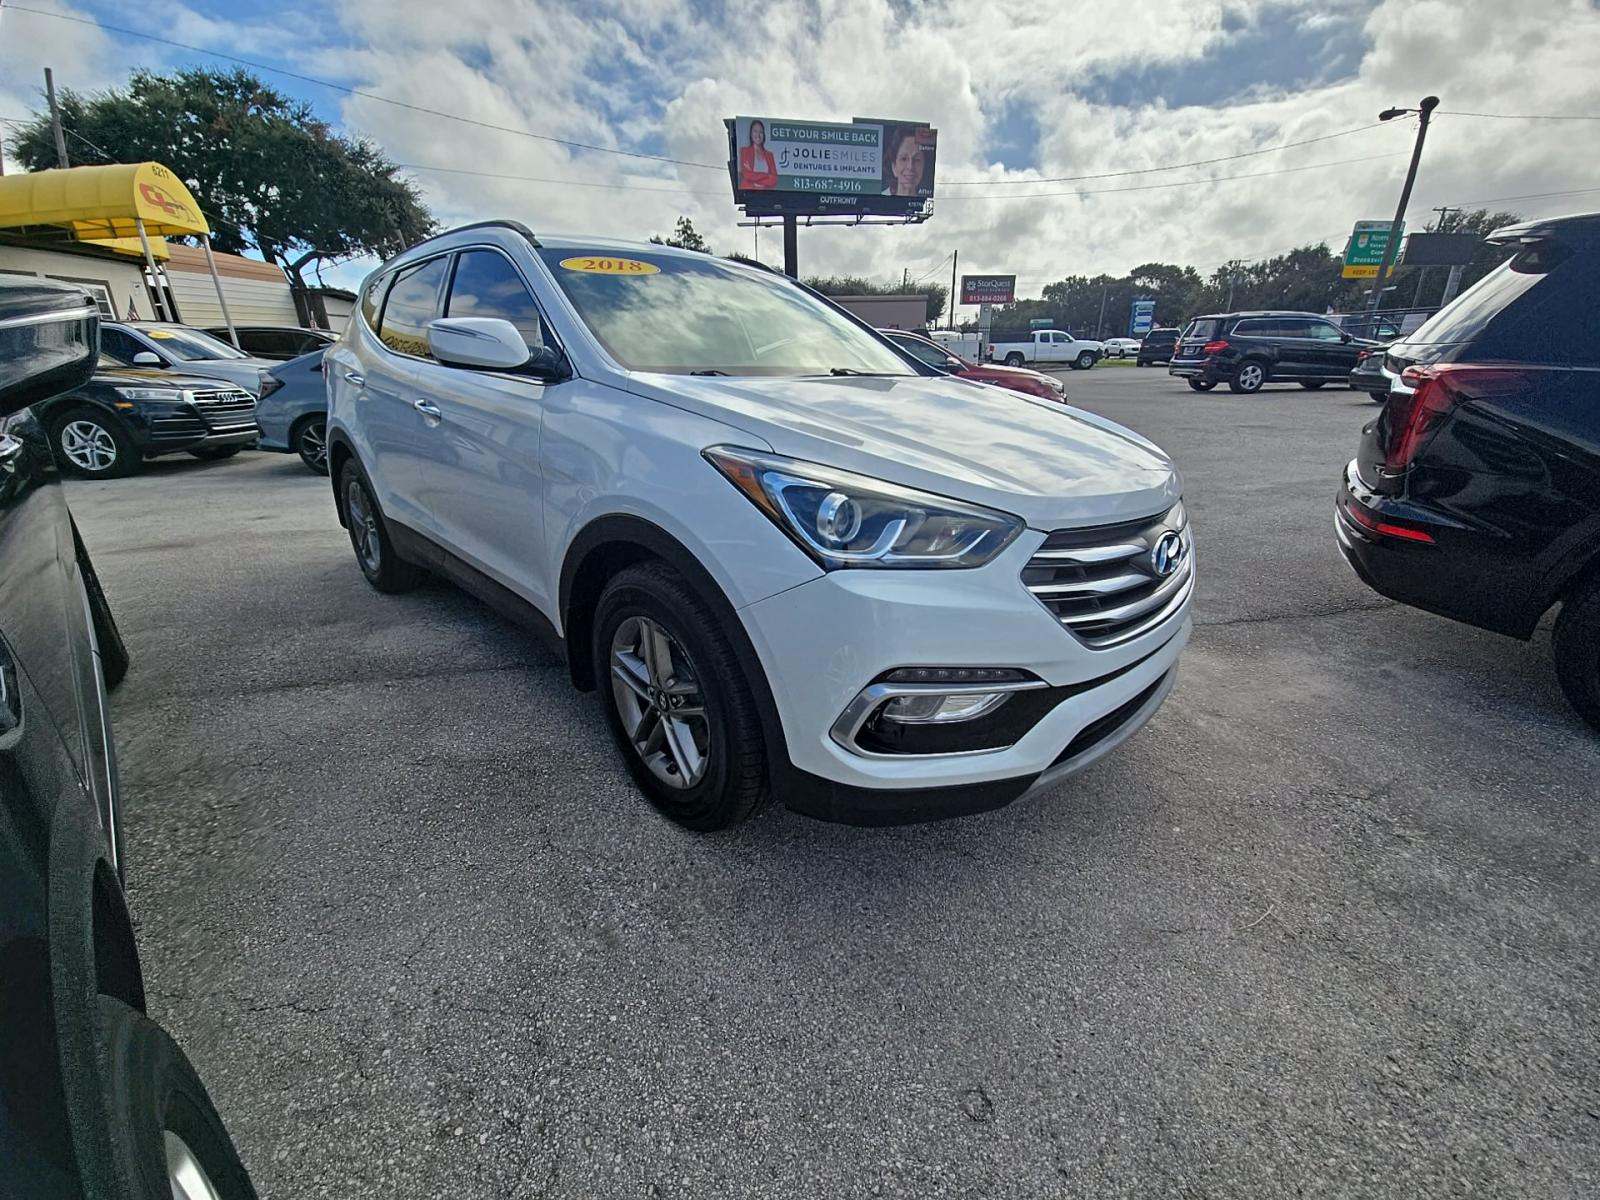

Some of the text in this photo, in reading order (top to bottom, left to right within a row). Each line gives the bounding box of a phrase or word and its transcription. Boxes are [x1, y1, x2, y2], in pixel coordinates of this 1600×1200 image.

[772, 127, 877, 143] GET YOUR SMILE BACK
[793, 162, 833, 171] DENTURES
[840, 165, 876, 173] IMPLANTS
[793, 178, 861, 191] 813-687-4916
[584, 260, 642, 271] 2018
[977, 280, 1010, 288] StorQuest
